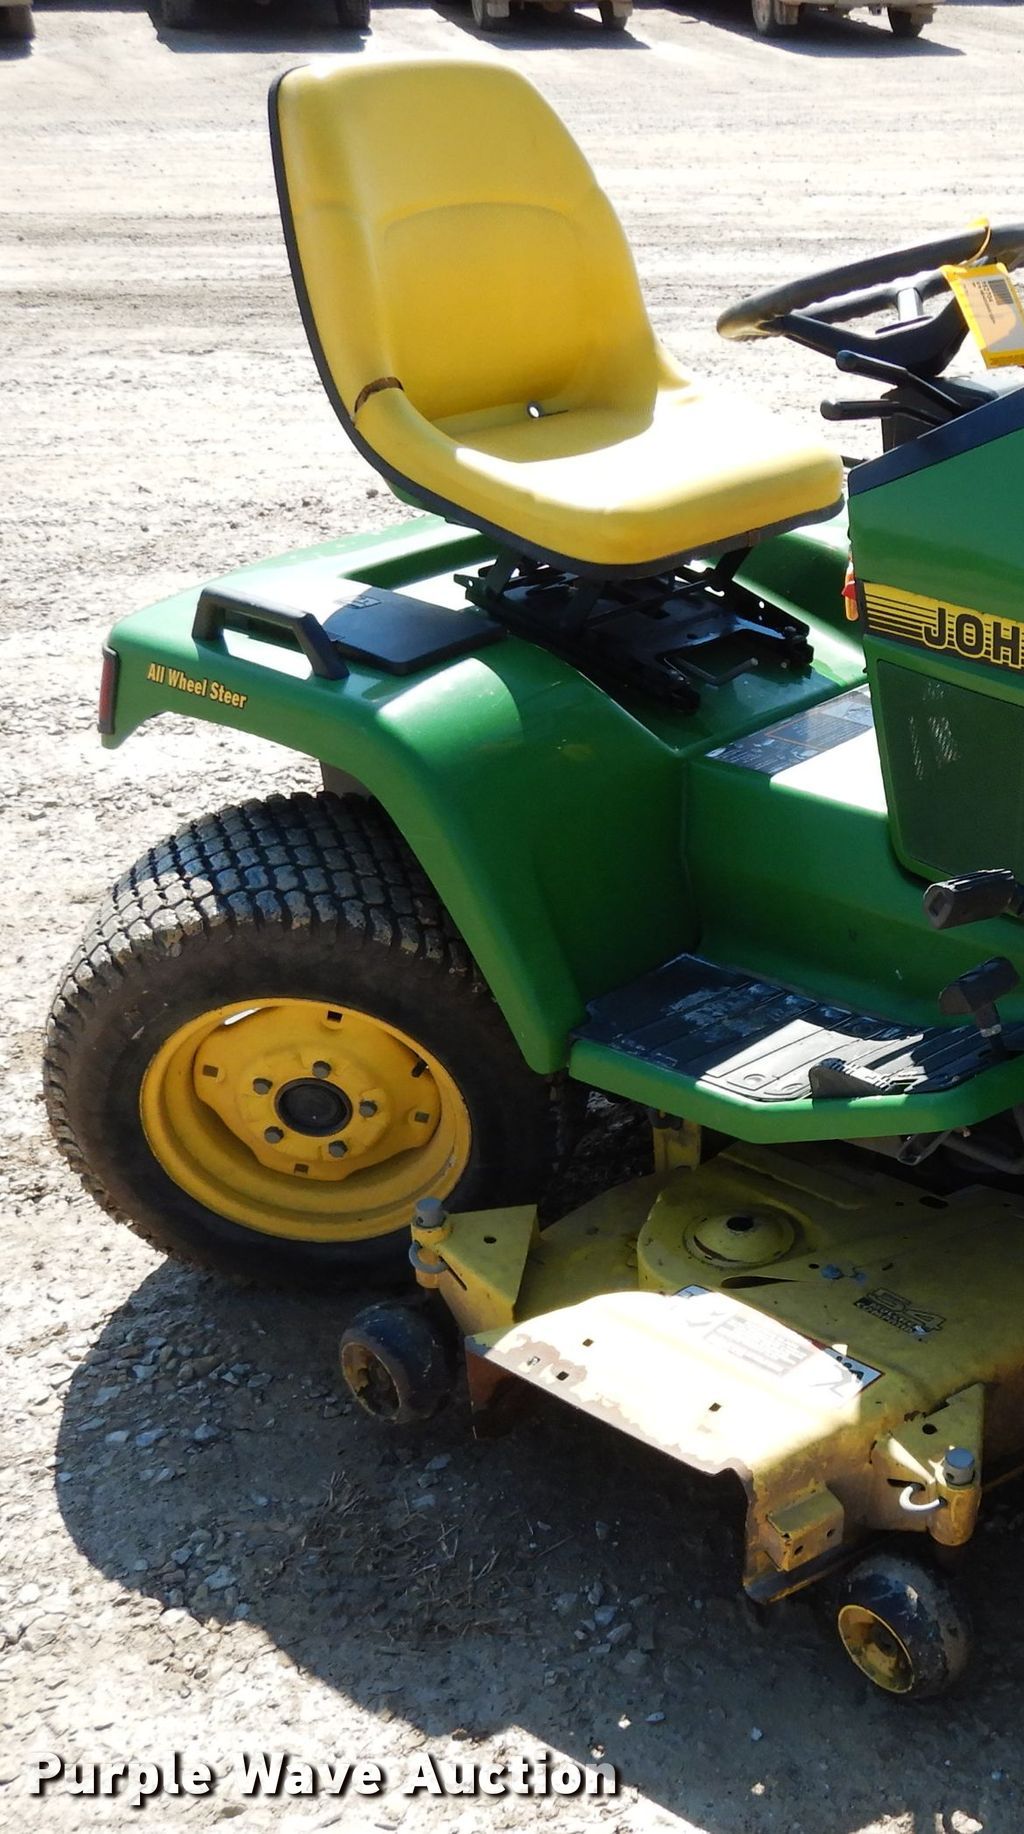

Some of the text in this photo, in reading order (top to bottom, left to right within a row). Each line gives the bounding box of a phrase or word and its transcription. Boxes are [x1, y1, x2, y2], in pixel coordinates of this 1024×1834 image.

[147, 663, 247, 708] All Wheel Steer
[866, 1287, 946, 1332] 54
